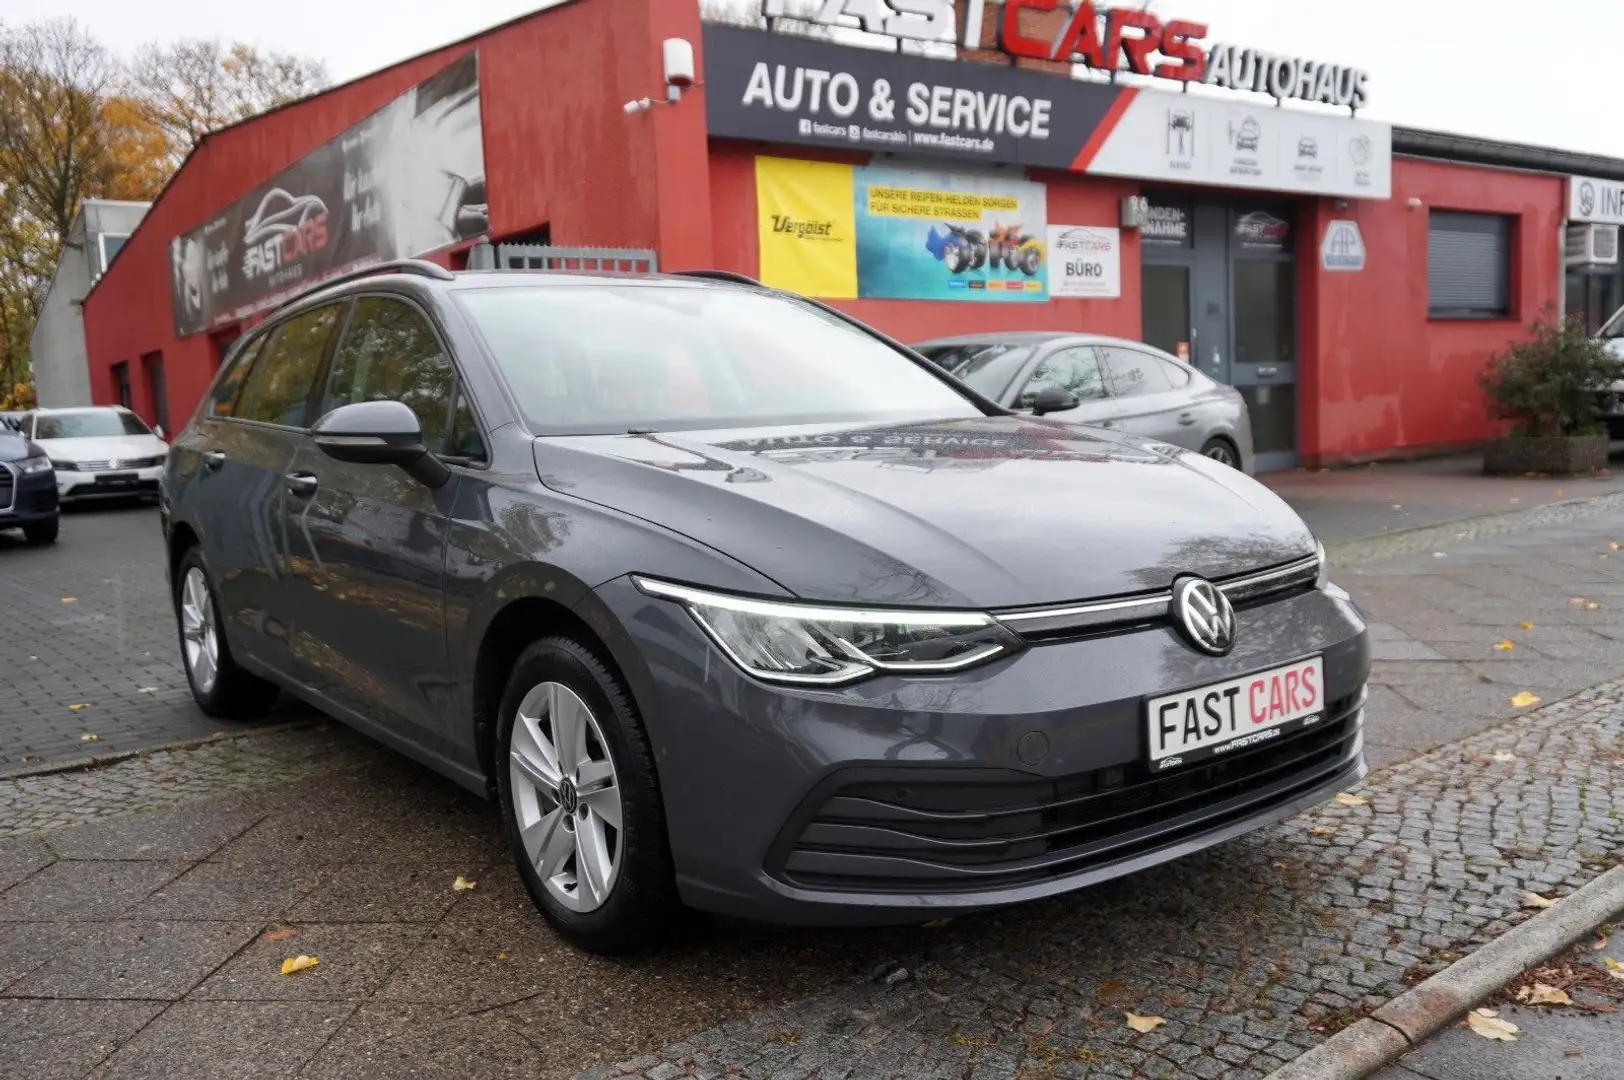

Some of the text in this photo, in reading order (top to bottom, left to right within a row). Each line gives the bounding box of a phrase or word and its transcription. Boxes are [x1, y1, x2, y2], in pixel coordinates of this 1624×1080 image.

[1205, 44, 1370, 108] AUTOHAUS
[742, 61, 1051, 138] AUTO & SERVICE
[812, 121, 847, 136] fastcars
[913, 131, 995, 150] www.fastcars.de
[870, 188, 1018, 209] UNSERE REIFEN-HELDEN SORGEN
[870, 201, 980, 219] FÜR SICHERE STRASSEN
[1066, 257, 1103, 277] BÜRO
[1158, 665, 1317, 750] FAST CARS
